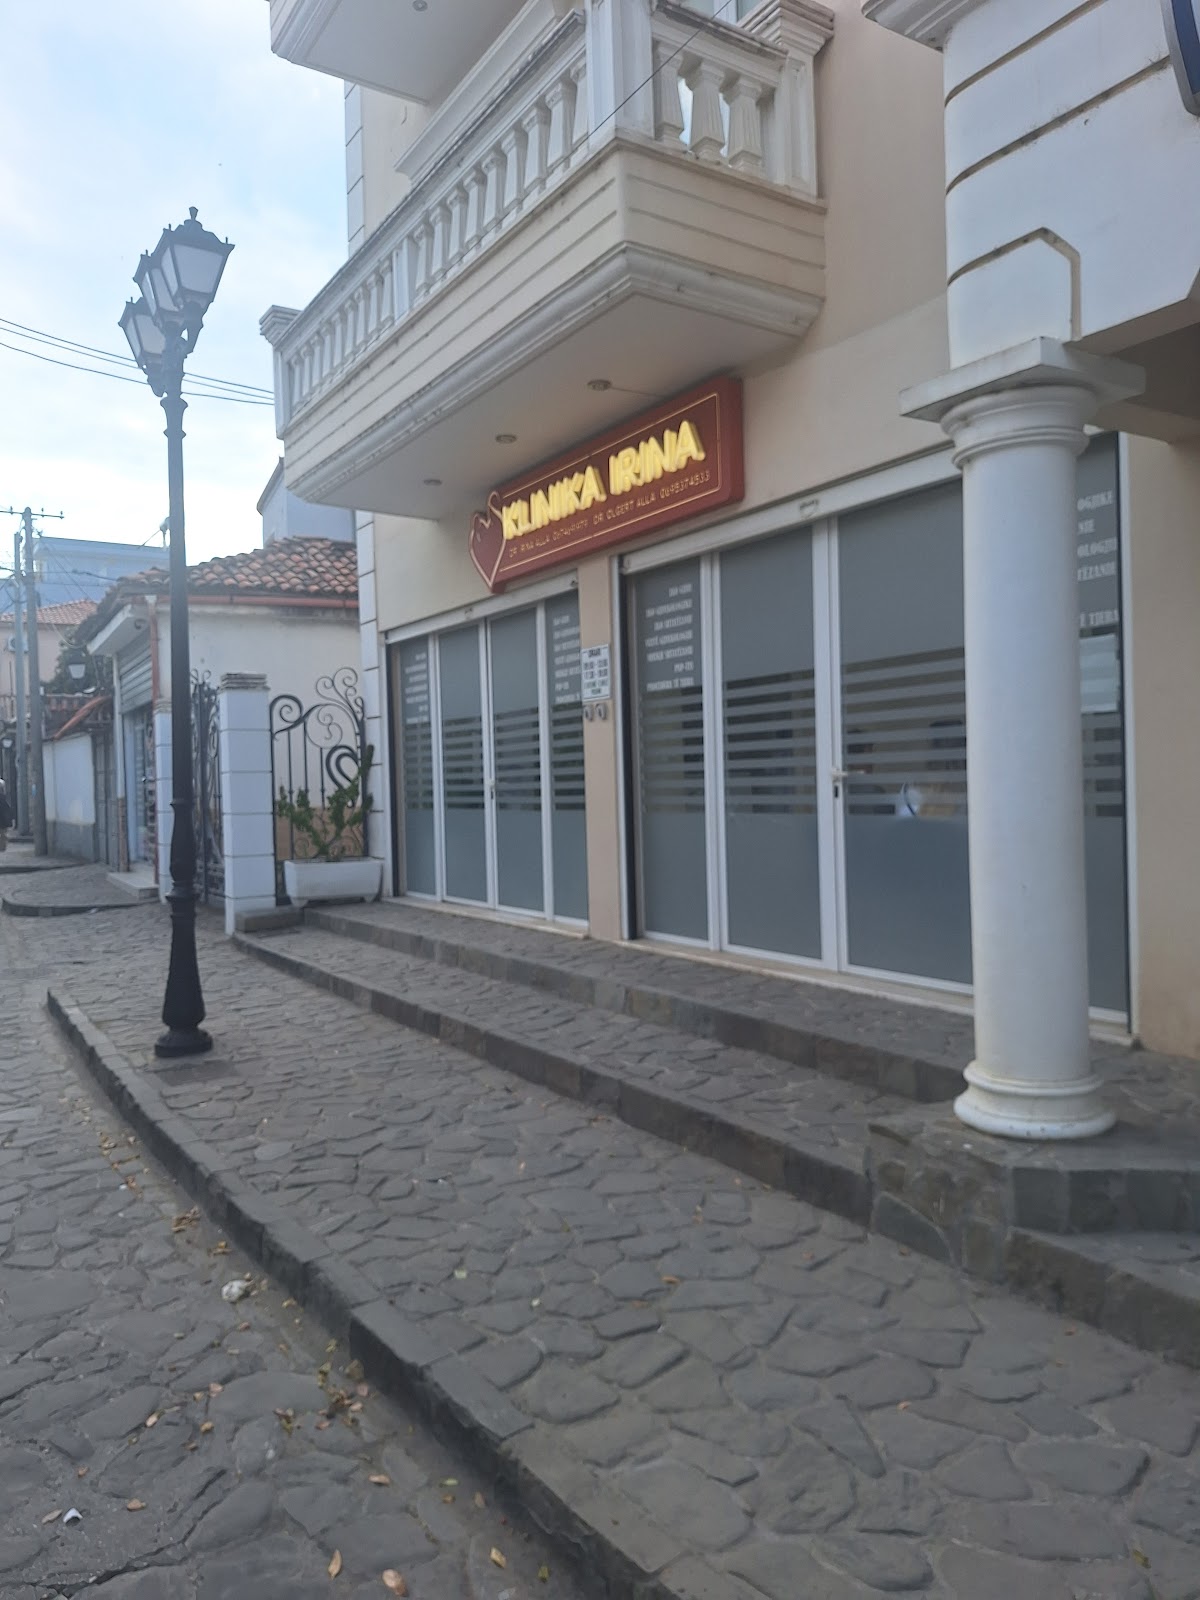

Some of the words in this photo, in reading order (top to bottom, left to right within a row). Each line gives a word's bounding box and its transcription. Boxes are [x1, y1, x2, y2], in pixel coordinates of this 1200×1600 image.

[502, 465, 606, 540] KLINIKA
[609, 420, 706, 495] IRINA
[636, 493, 656, 509] ALLA
